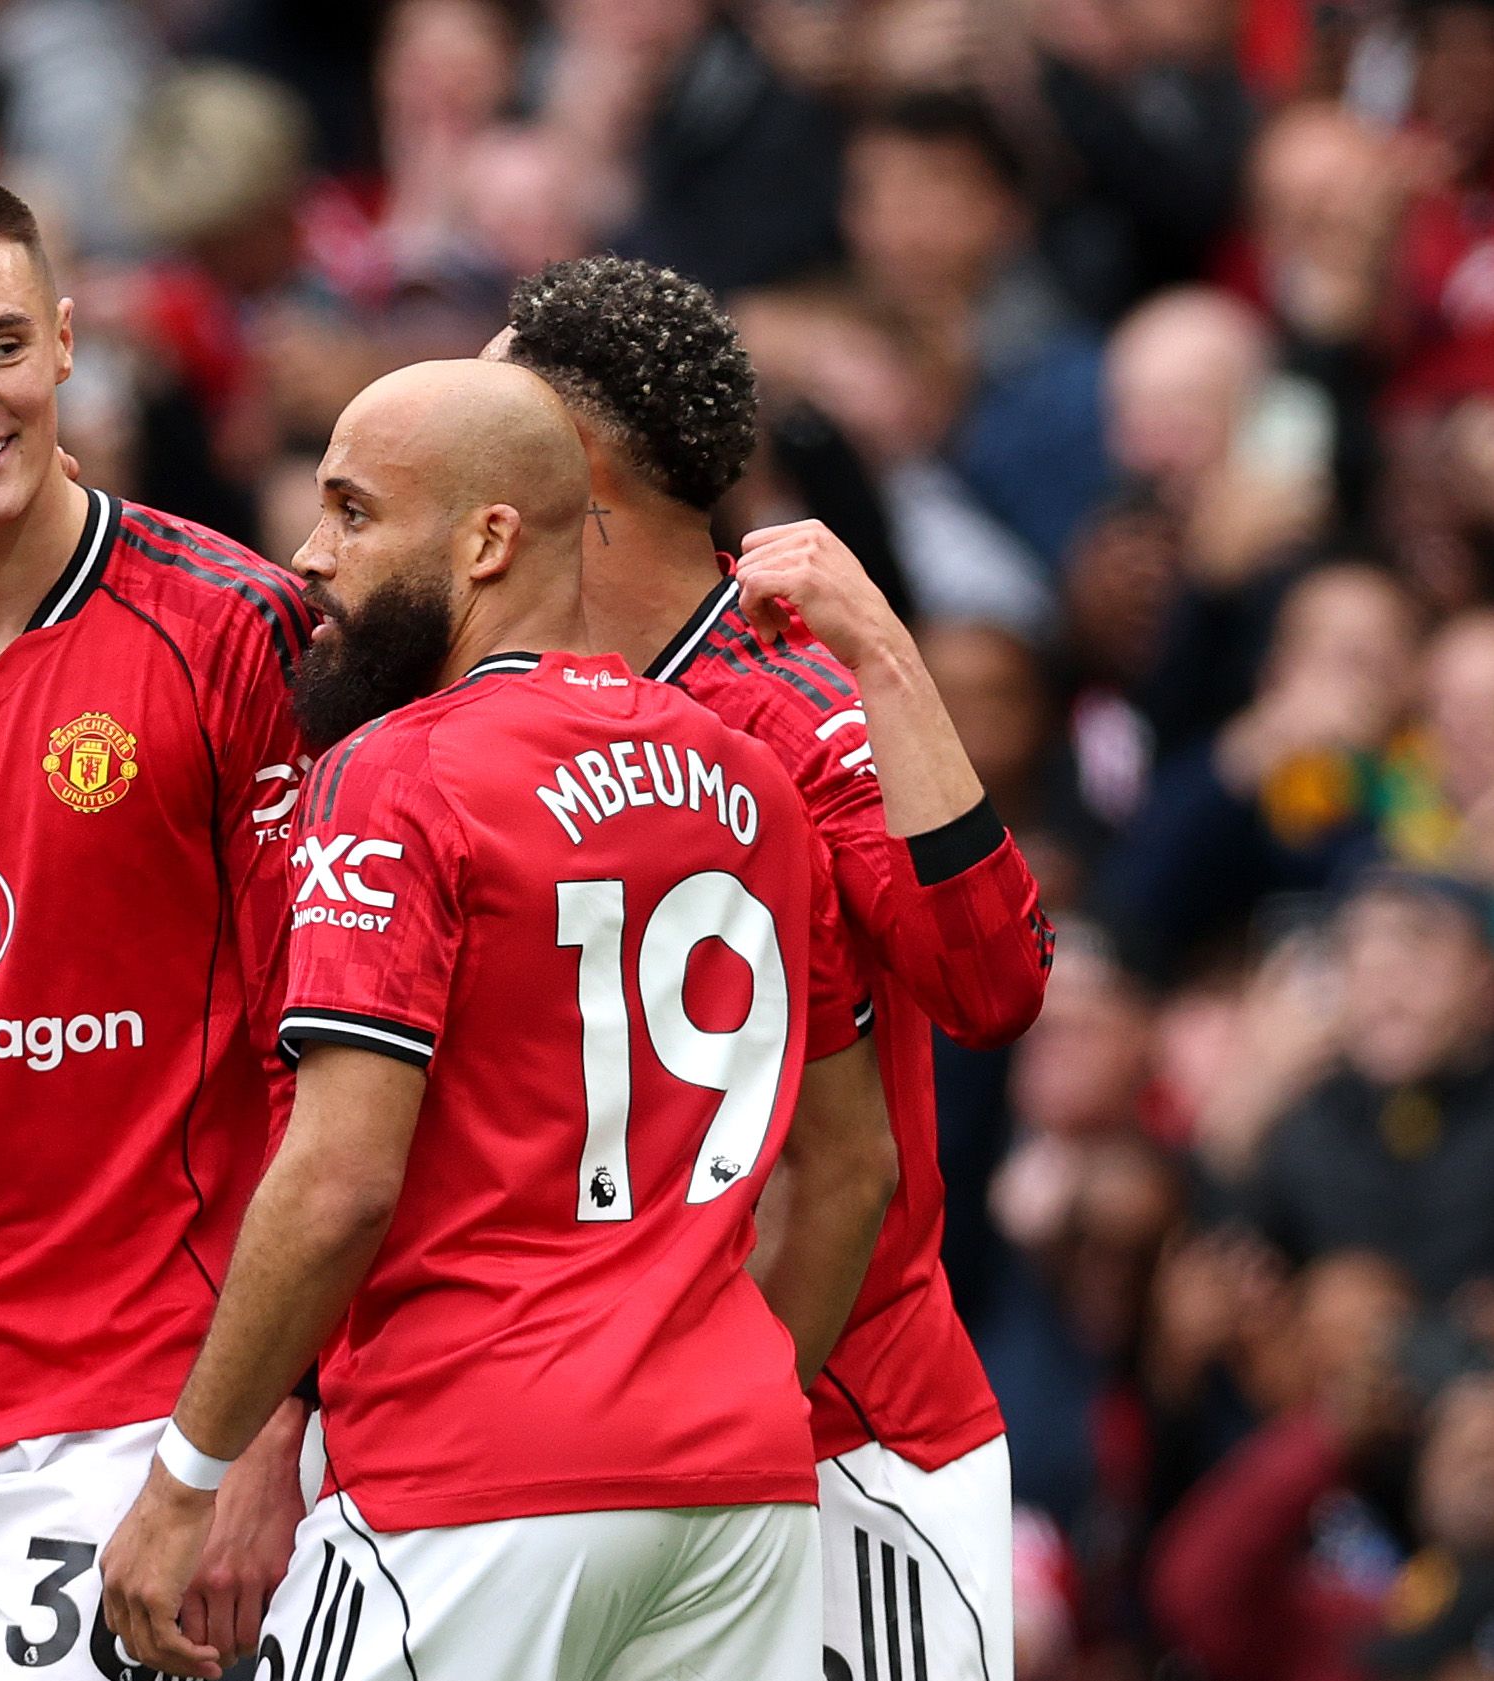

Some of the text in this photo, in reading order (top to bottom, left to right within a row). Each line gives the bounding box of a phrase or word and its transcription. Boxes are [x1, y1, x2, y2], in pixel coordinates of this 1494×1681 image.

[55, 718, 131, 755] MANCHESTER
[61, 783, 116, 807] UNITED
[536, 741, 758, 846] MBEUMO
[555, 868, 790, 1223] 19
